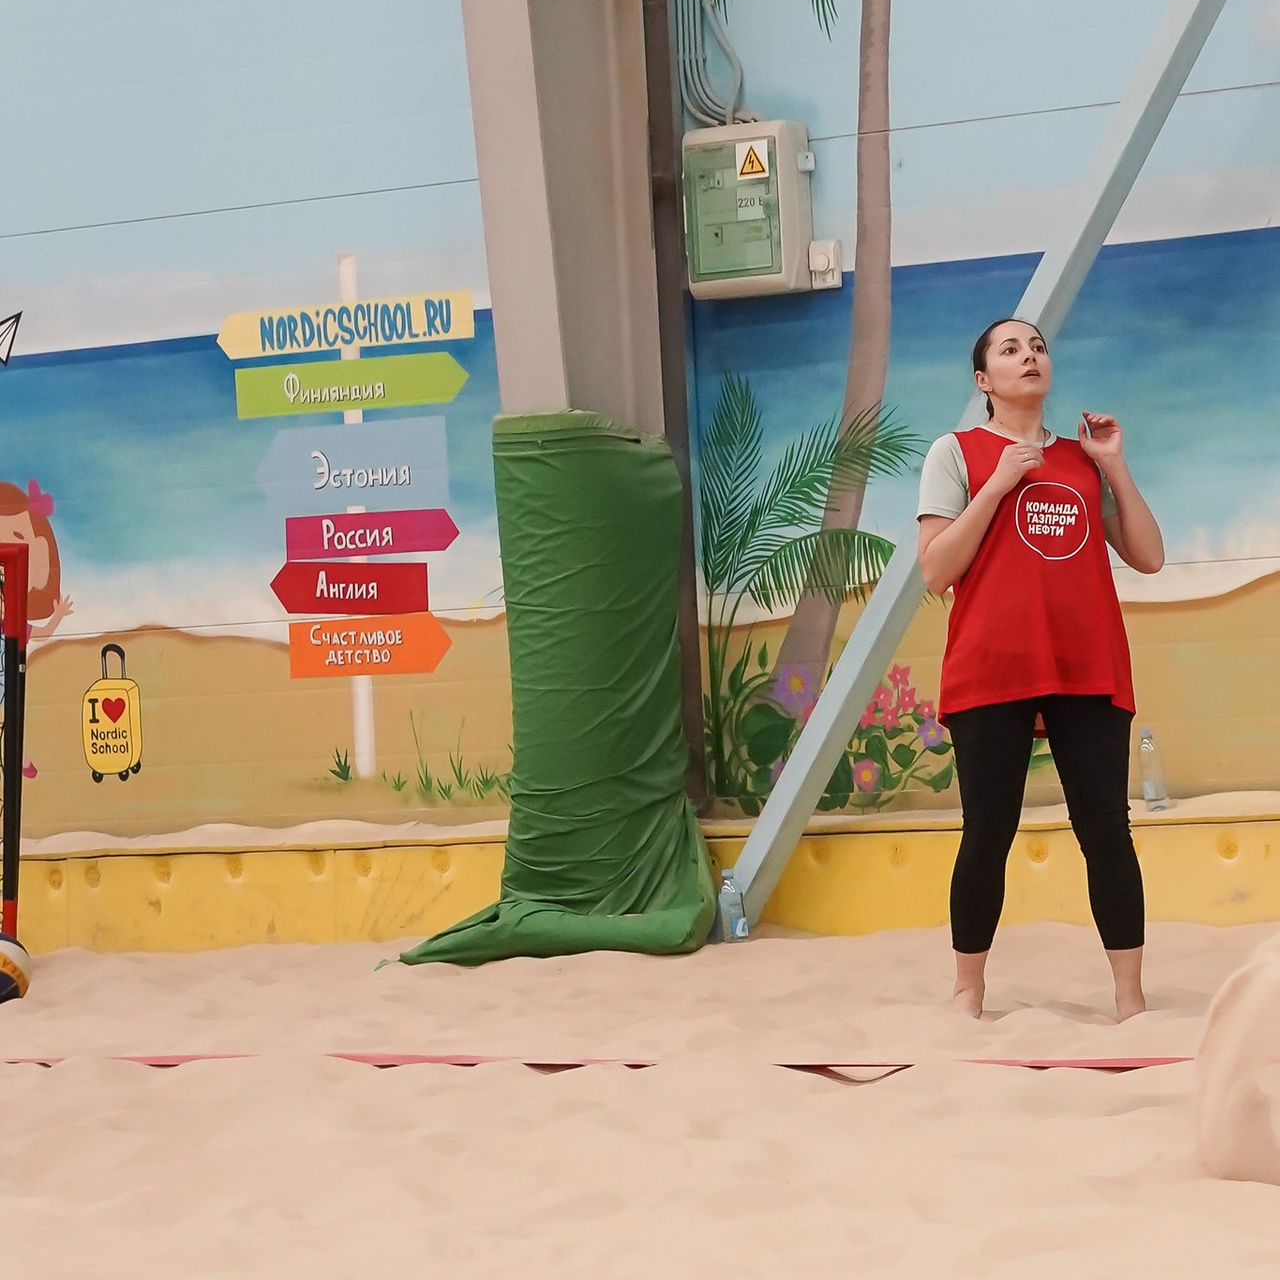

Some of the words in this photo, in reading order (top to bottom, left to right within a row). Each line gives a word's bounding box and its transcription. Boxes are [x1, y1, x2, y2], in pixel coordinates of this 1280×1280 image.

[738, 197, 755, 208] 220
[311, 450, 412, 490] Эстония
[1026, 502, 1078, 514] КОМАНДА
[1027, 513, 1076, 526] ГАЗПРОМ
[321, 519, 394, 551] Россия
[1028, 524, 1064, 536] НЕФТИ
[315, 570, 378, 600] Англия
[88, 698, 100, 724] I
[91, 727, 128, 741] Nordic
[91, 741, 129, 755] School
